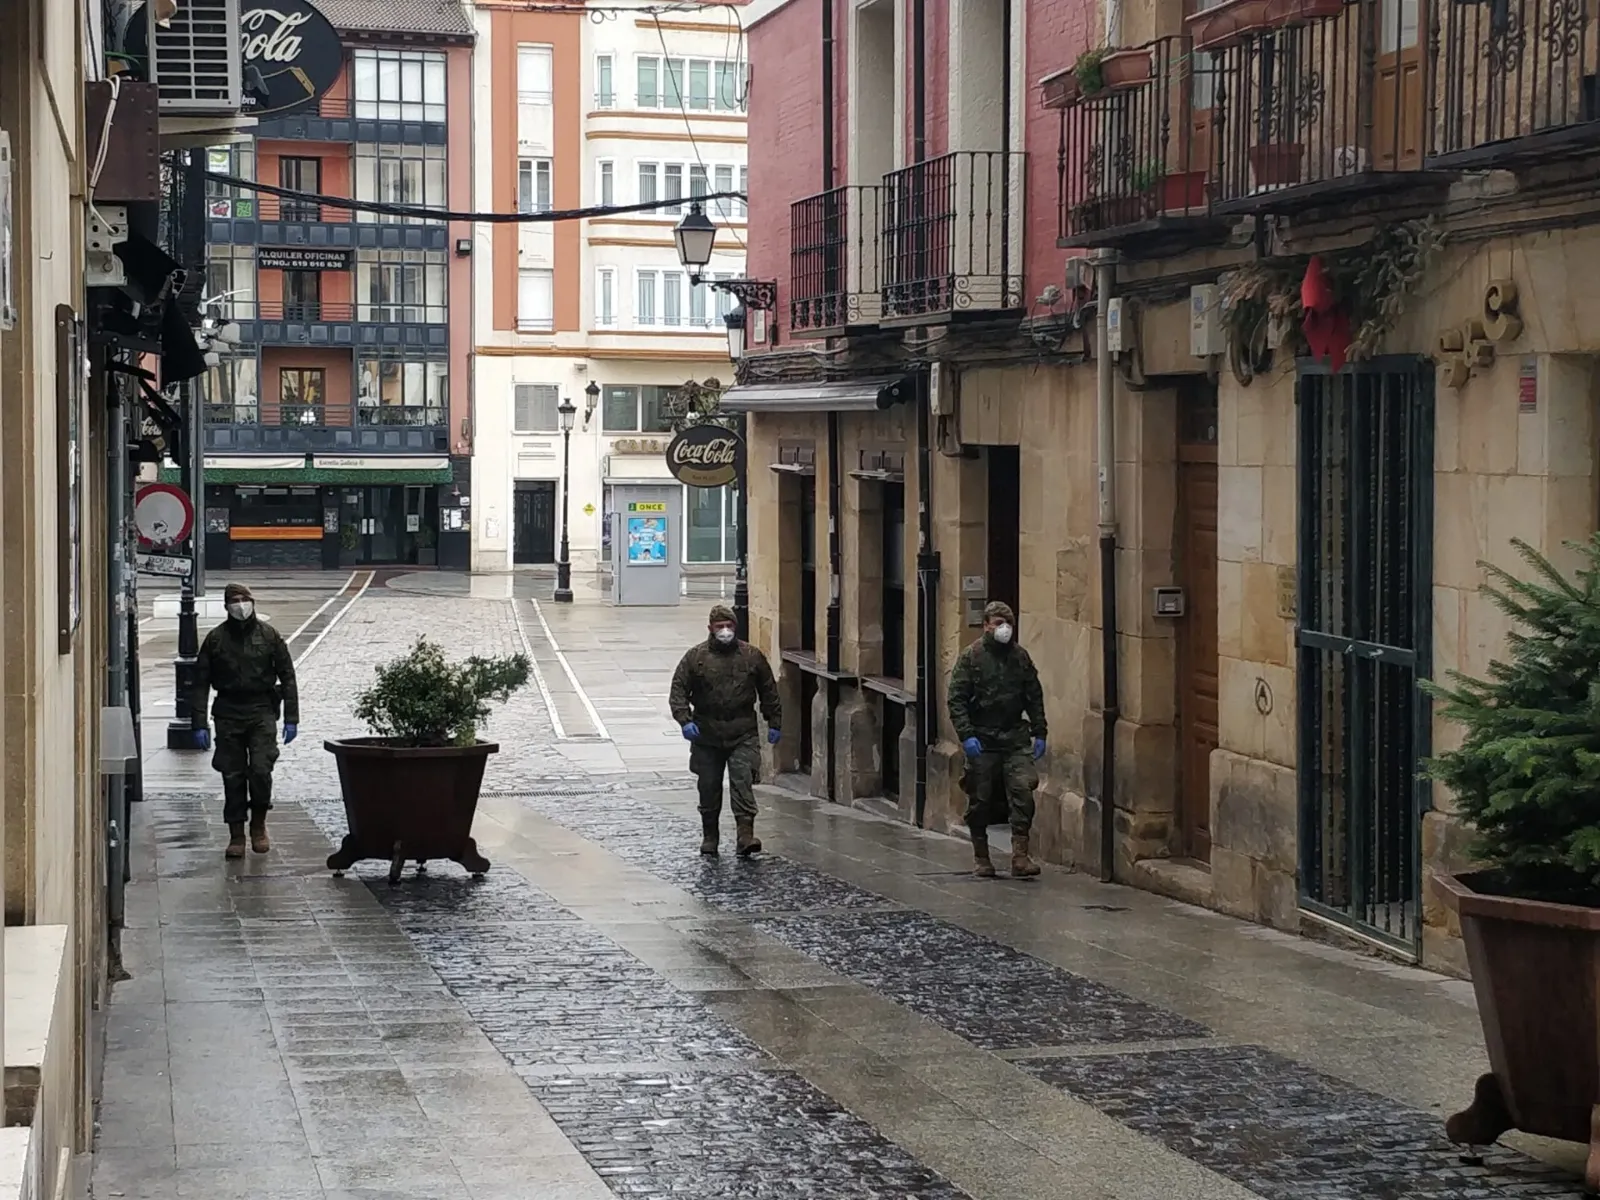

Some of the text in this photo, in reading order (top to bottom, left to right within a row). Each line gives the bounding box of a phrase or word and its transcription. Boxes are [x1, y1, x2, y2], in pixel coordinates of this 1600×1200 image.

[259, 251, 346, 261] ALQUILER OFICINAS
[638, 503, 664, 511] ONCE
